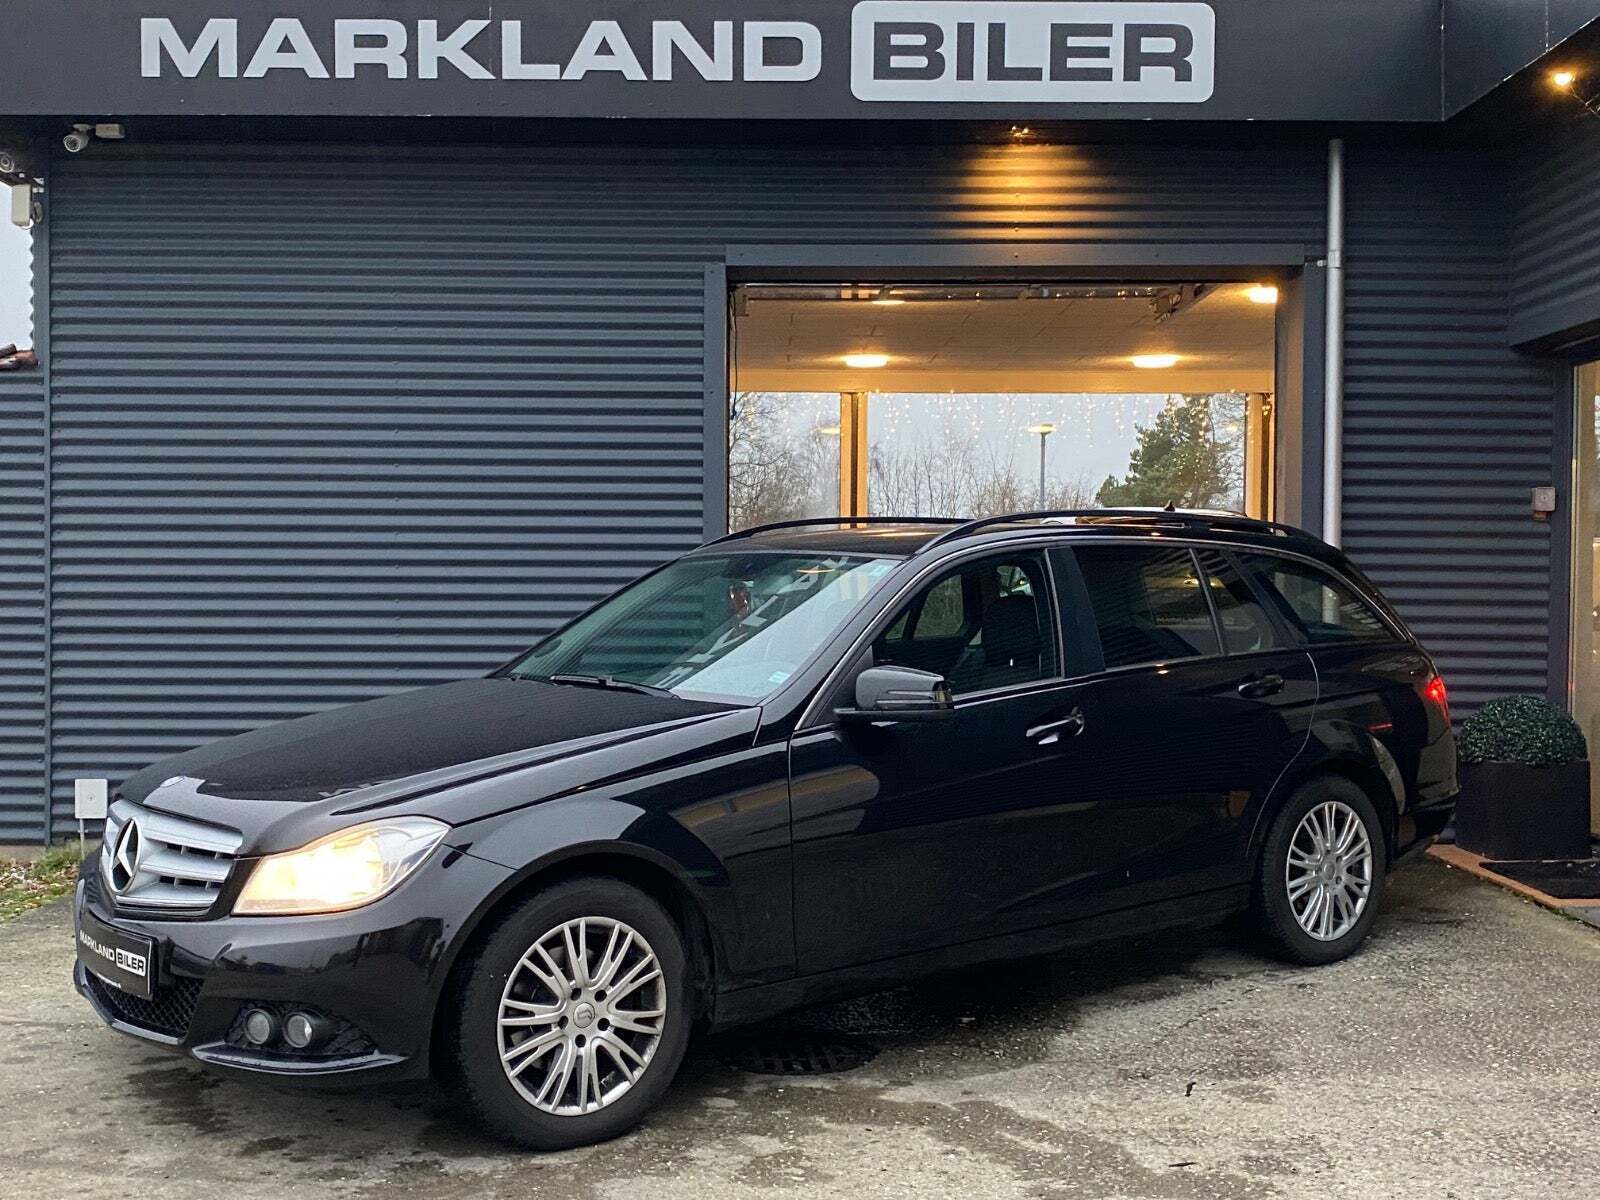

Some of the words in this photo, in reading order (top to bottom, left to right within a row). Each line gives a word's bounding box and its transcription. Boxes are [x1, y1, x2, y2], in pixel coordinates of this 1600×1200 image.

[140, 17, 822, 82] MARKLAND
[873, 22, 1194, 82] BILER
[80, 929, 115, 962] MARKLAND
[116, 952, 146, 973] BILER
